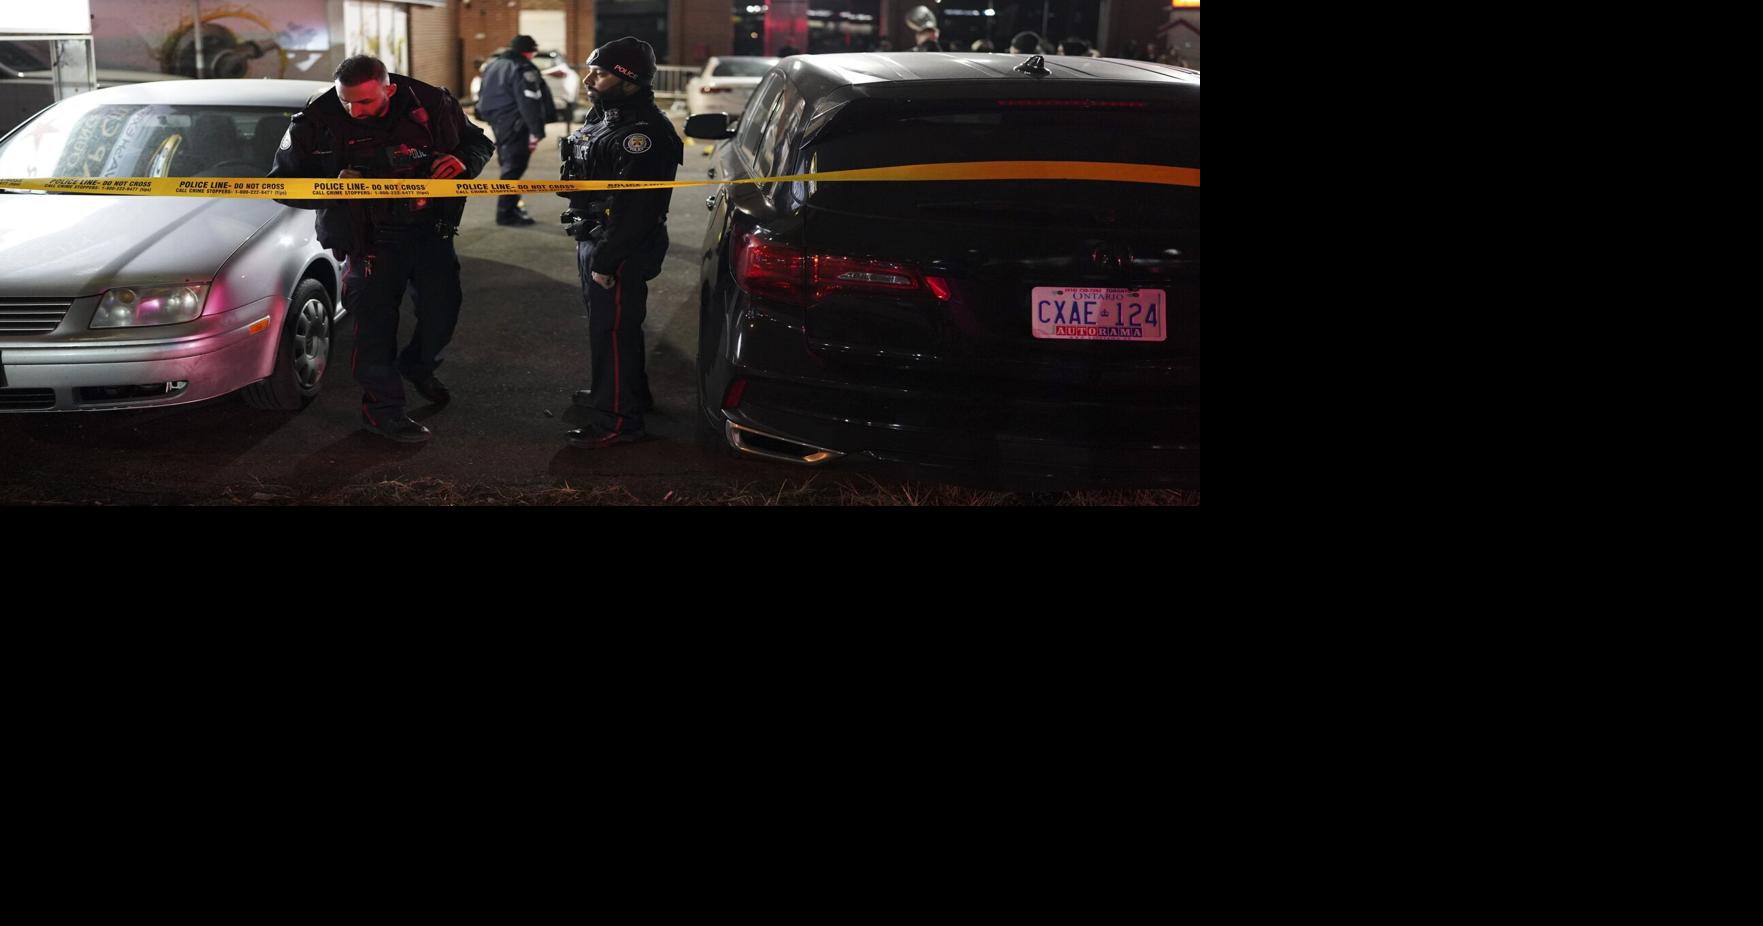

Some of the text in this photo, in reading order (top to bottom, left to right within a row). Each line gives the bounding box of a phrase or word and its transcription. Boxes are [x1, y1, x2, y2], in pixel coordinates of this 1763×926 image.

[180, 181, 208, 189] POLICE
[314, 182, 344, 190] POLICE
[1038, 300, 1158, 328] CXAE 124
[1056, 326, 1142, 337] AUTORAMA
